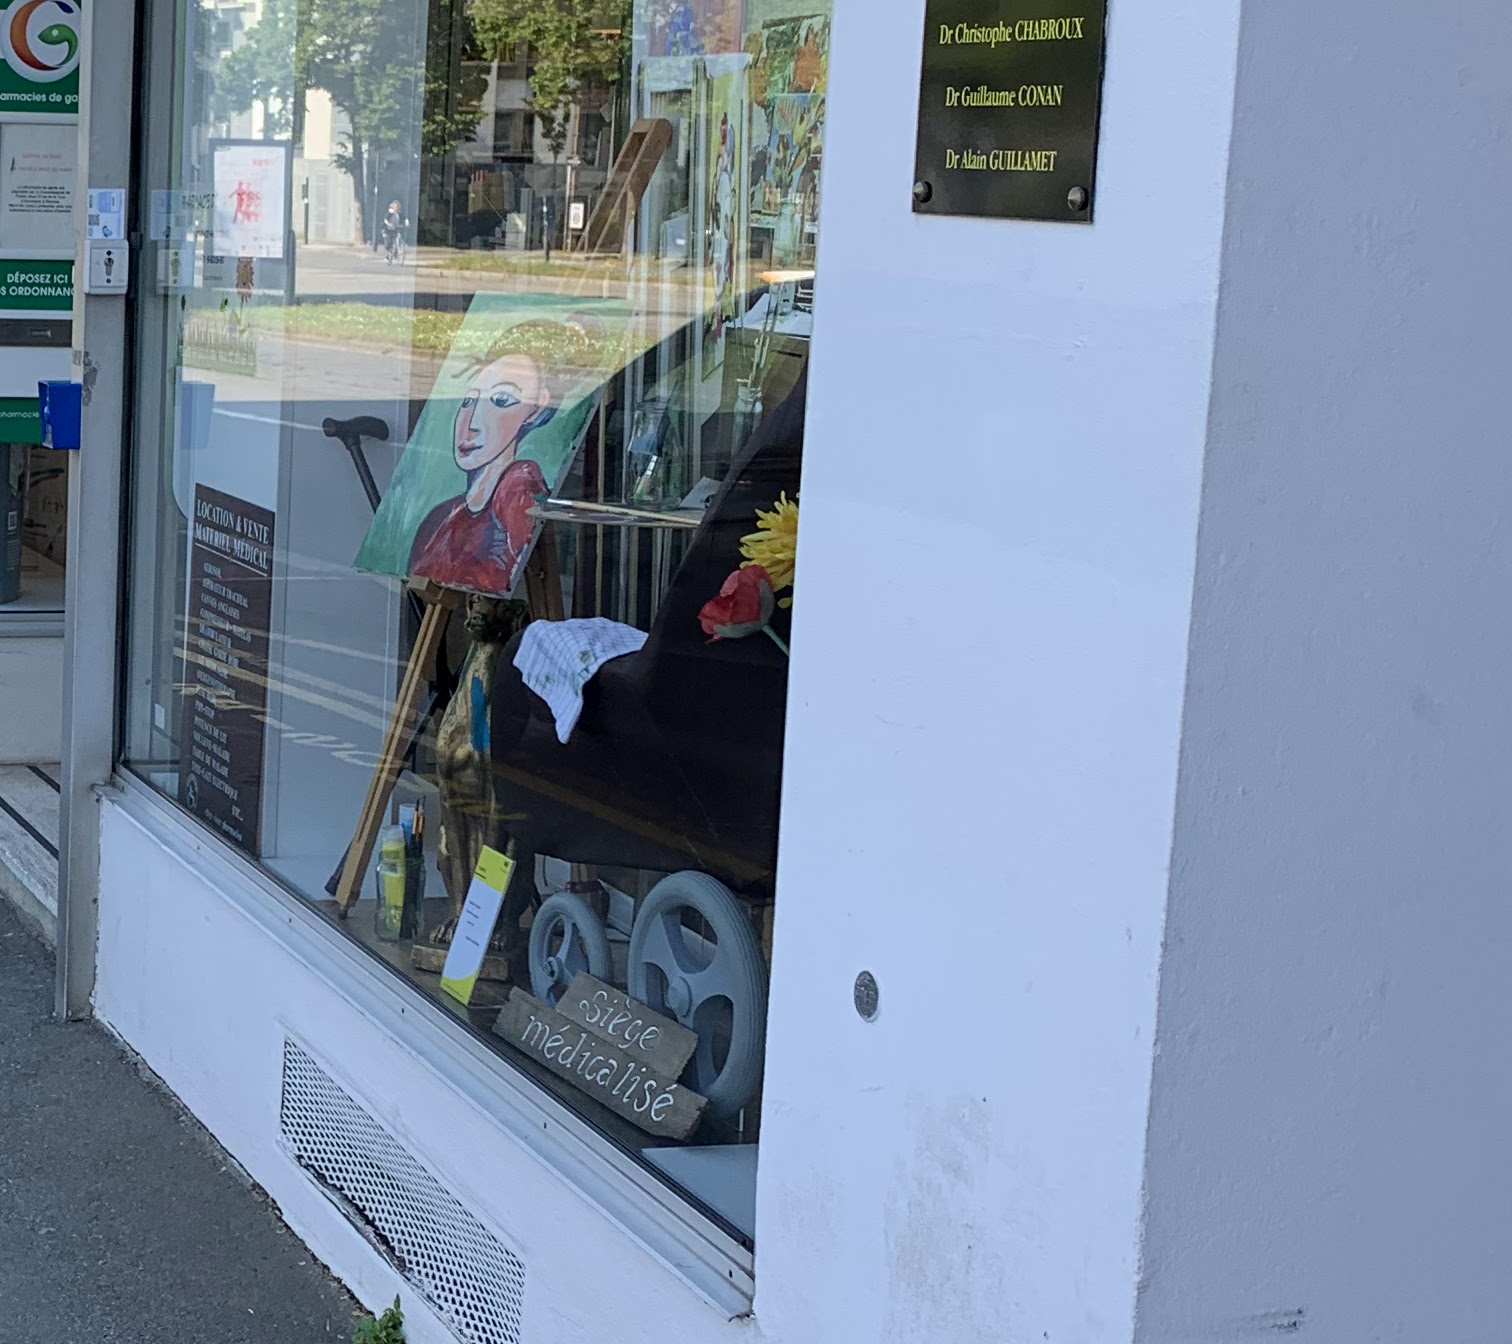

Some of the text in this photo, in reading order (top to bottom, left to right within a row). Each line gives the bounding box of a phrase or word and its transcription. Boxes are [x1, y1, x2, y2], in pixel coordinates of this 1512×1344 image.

[939, 17, 1085, 48] Dr Christophe CHABROUX
[48, 91, 63, 103] de
[945, 84, 1064, 107] Dr Guillaume CONAN
[945, 148, 1058, 172] Dr Alain GUILLAMET
[6, 271, 68, 284] DÉPOSEZ ICI
[196, 498, 235, 532] LOCATION
[243, 516, 269, 546] VENTE
[194, 522, 231, 554] MATERIEL
[579, 989, 660, 1051] Siège
[521, 1015, 678, 1122] médicalisé
